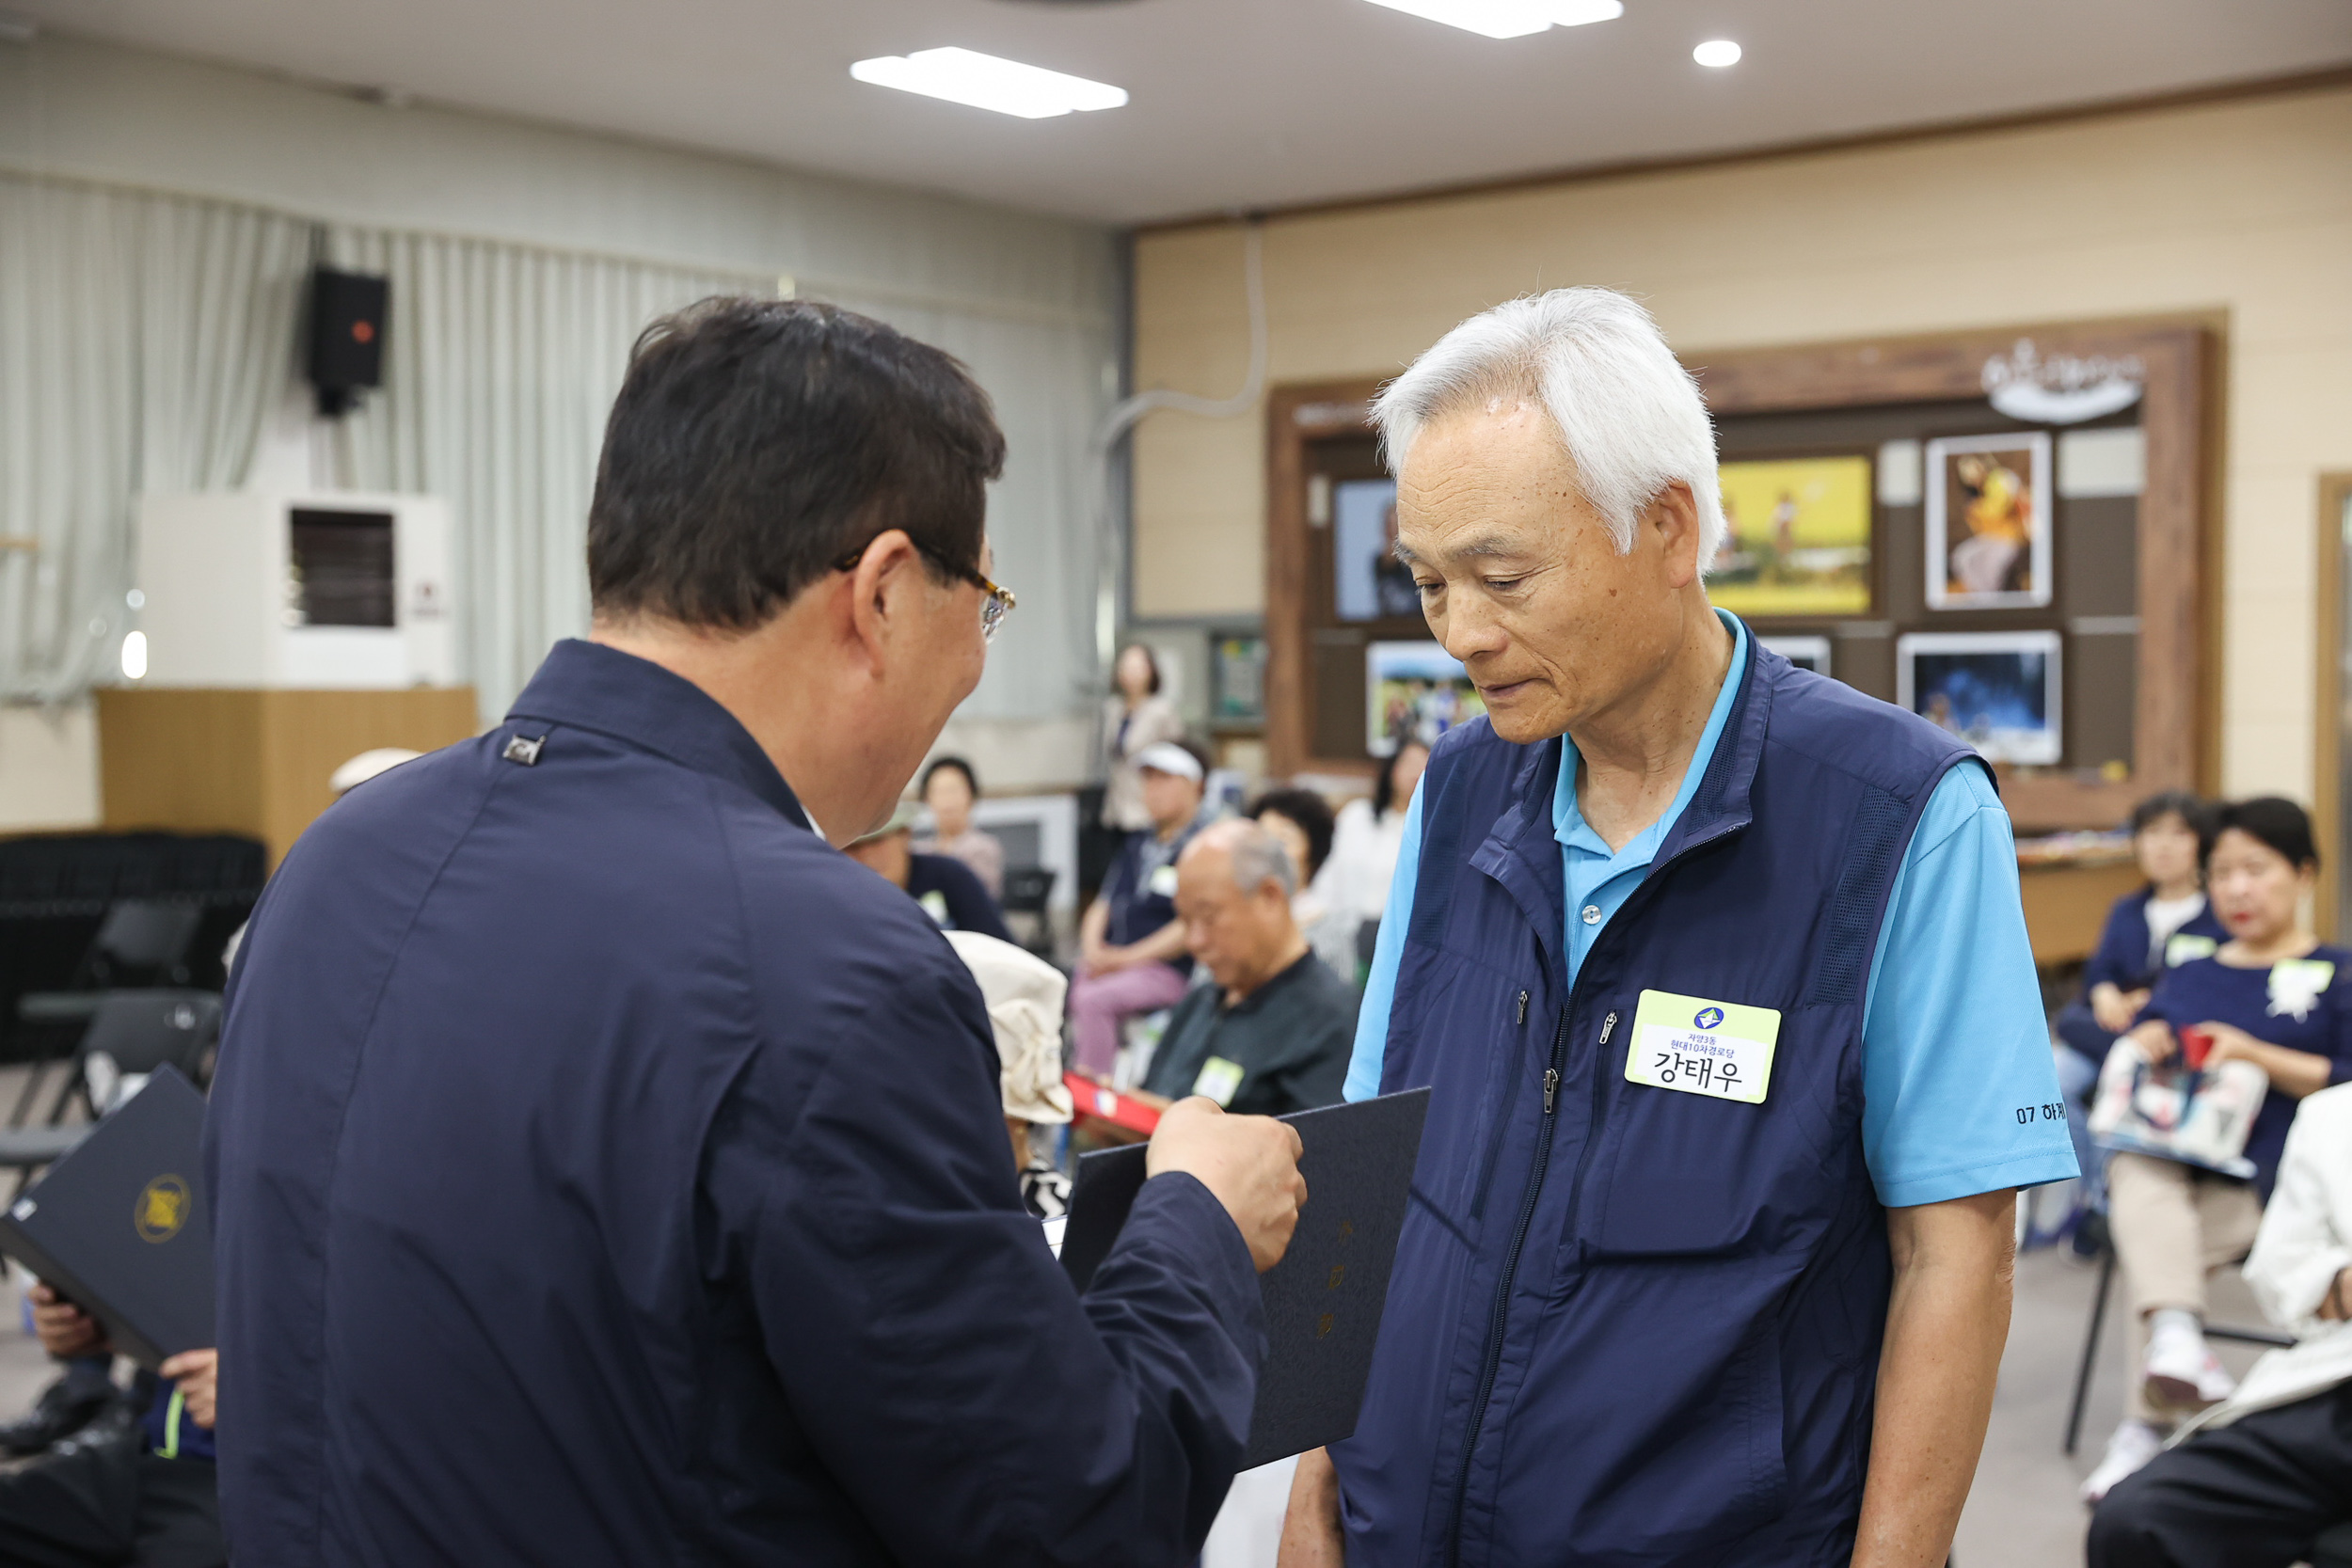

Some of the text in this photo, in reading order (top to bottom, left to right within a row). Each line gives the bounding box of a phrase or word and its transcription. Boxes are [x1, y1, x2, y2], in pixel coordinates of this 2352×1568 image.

[1688, 1034, 1717, 1046] 자양3동
[1671, 1040, 1735, 1059] 현대10차경로당
[1654, 1053, 1742, 1093] 강태우
[2016, 1106, 2035, 1124] 07
